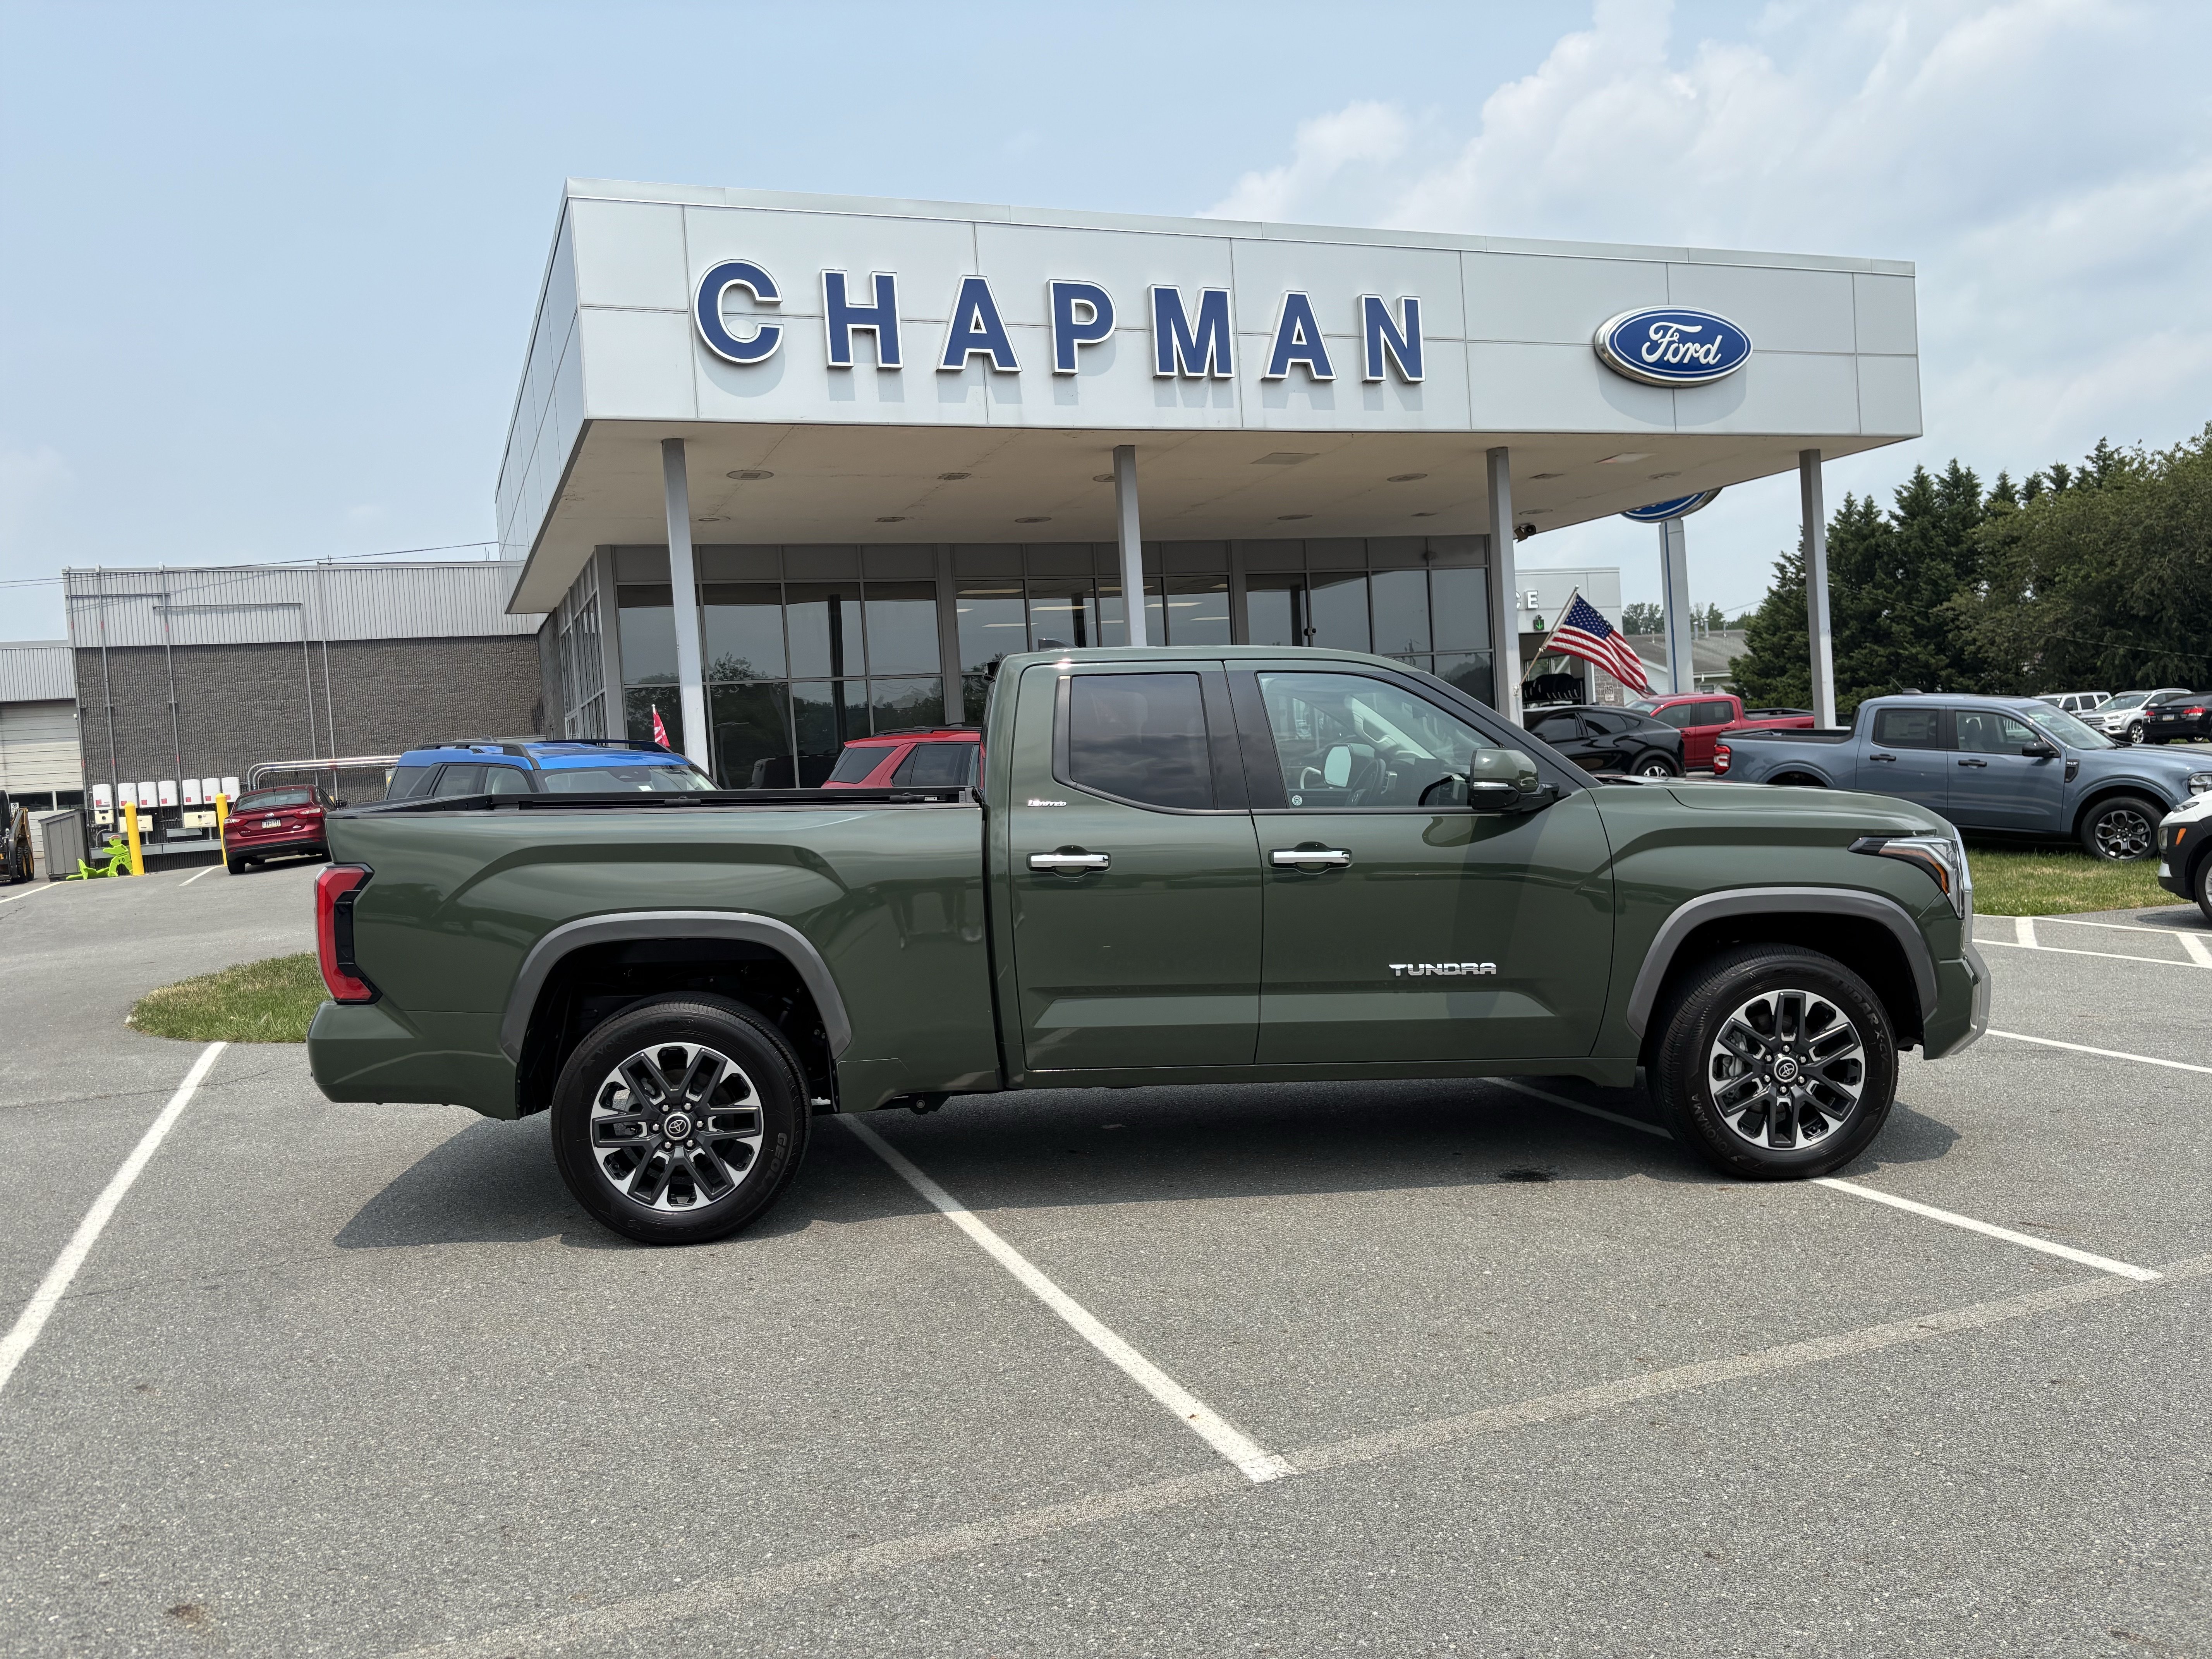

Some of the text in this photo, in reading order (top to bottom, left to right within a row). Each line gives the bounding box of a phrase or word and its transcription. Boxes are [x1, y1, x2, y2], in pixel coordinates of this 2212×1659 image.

[694, 259, 1425, 384] CHAPMAN
[1642, 322, 1723, 365] Ford
[1389, 962, 1496, 976] TUNDRA
[1692, 1093, 1733, 1156] YOKOHAMA
